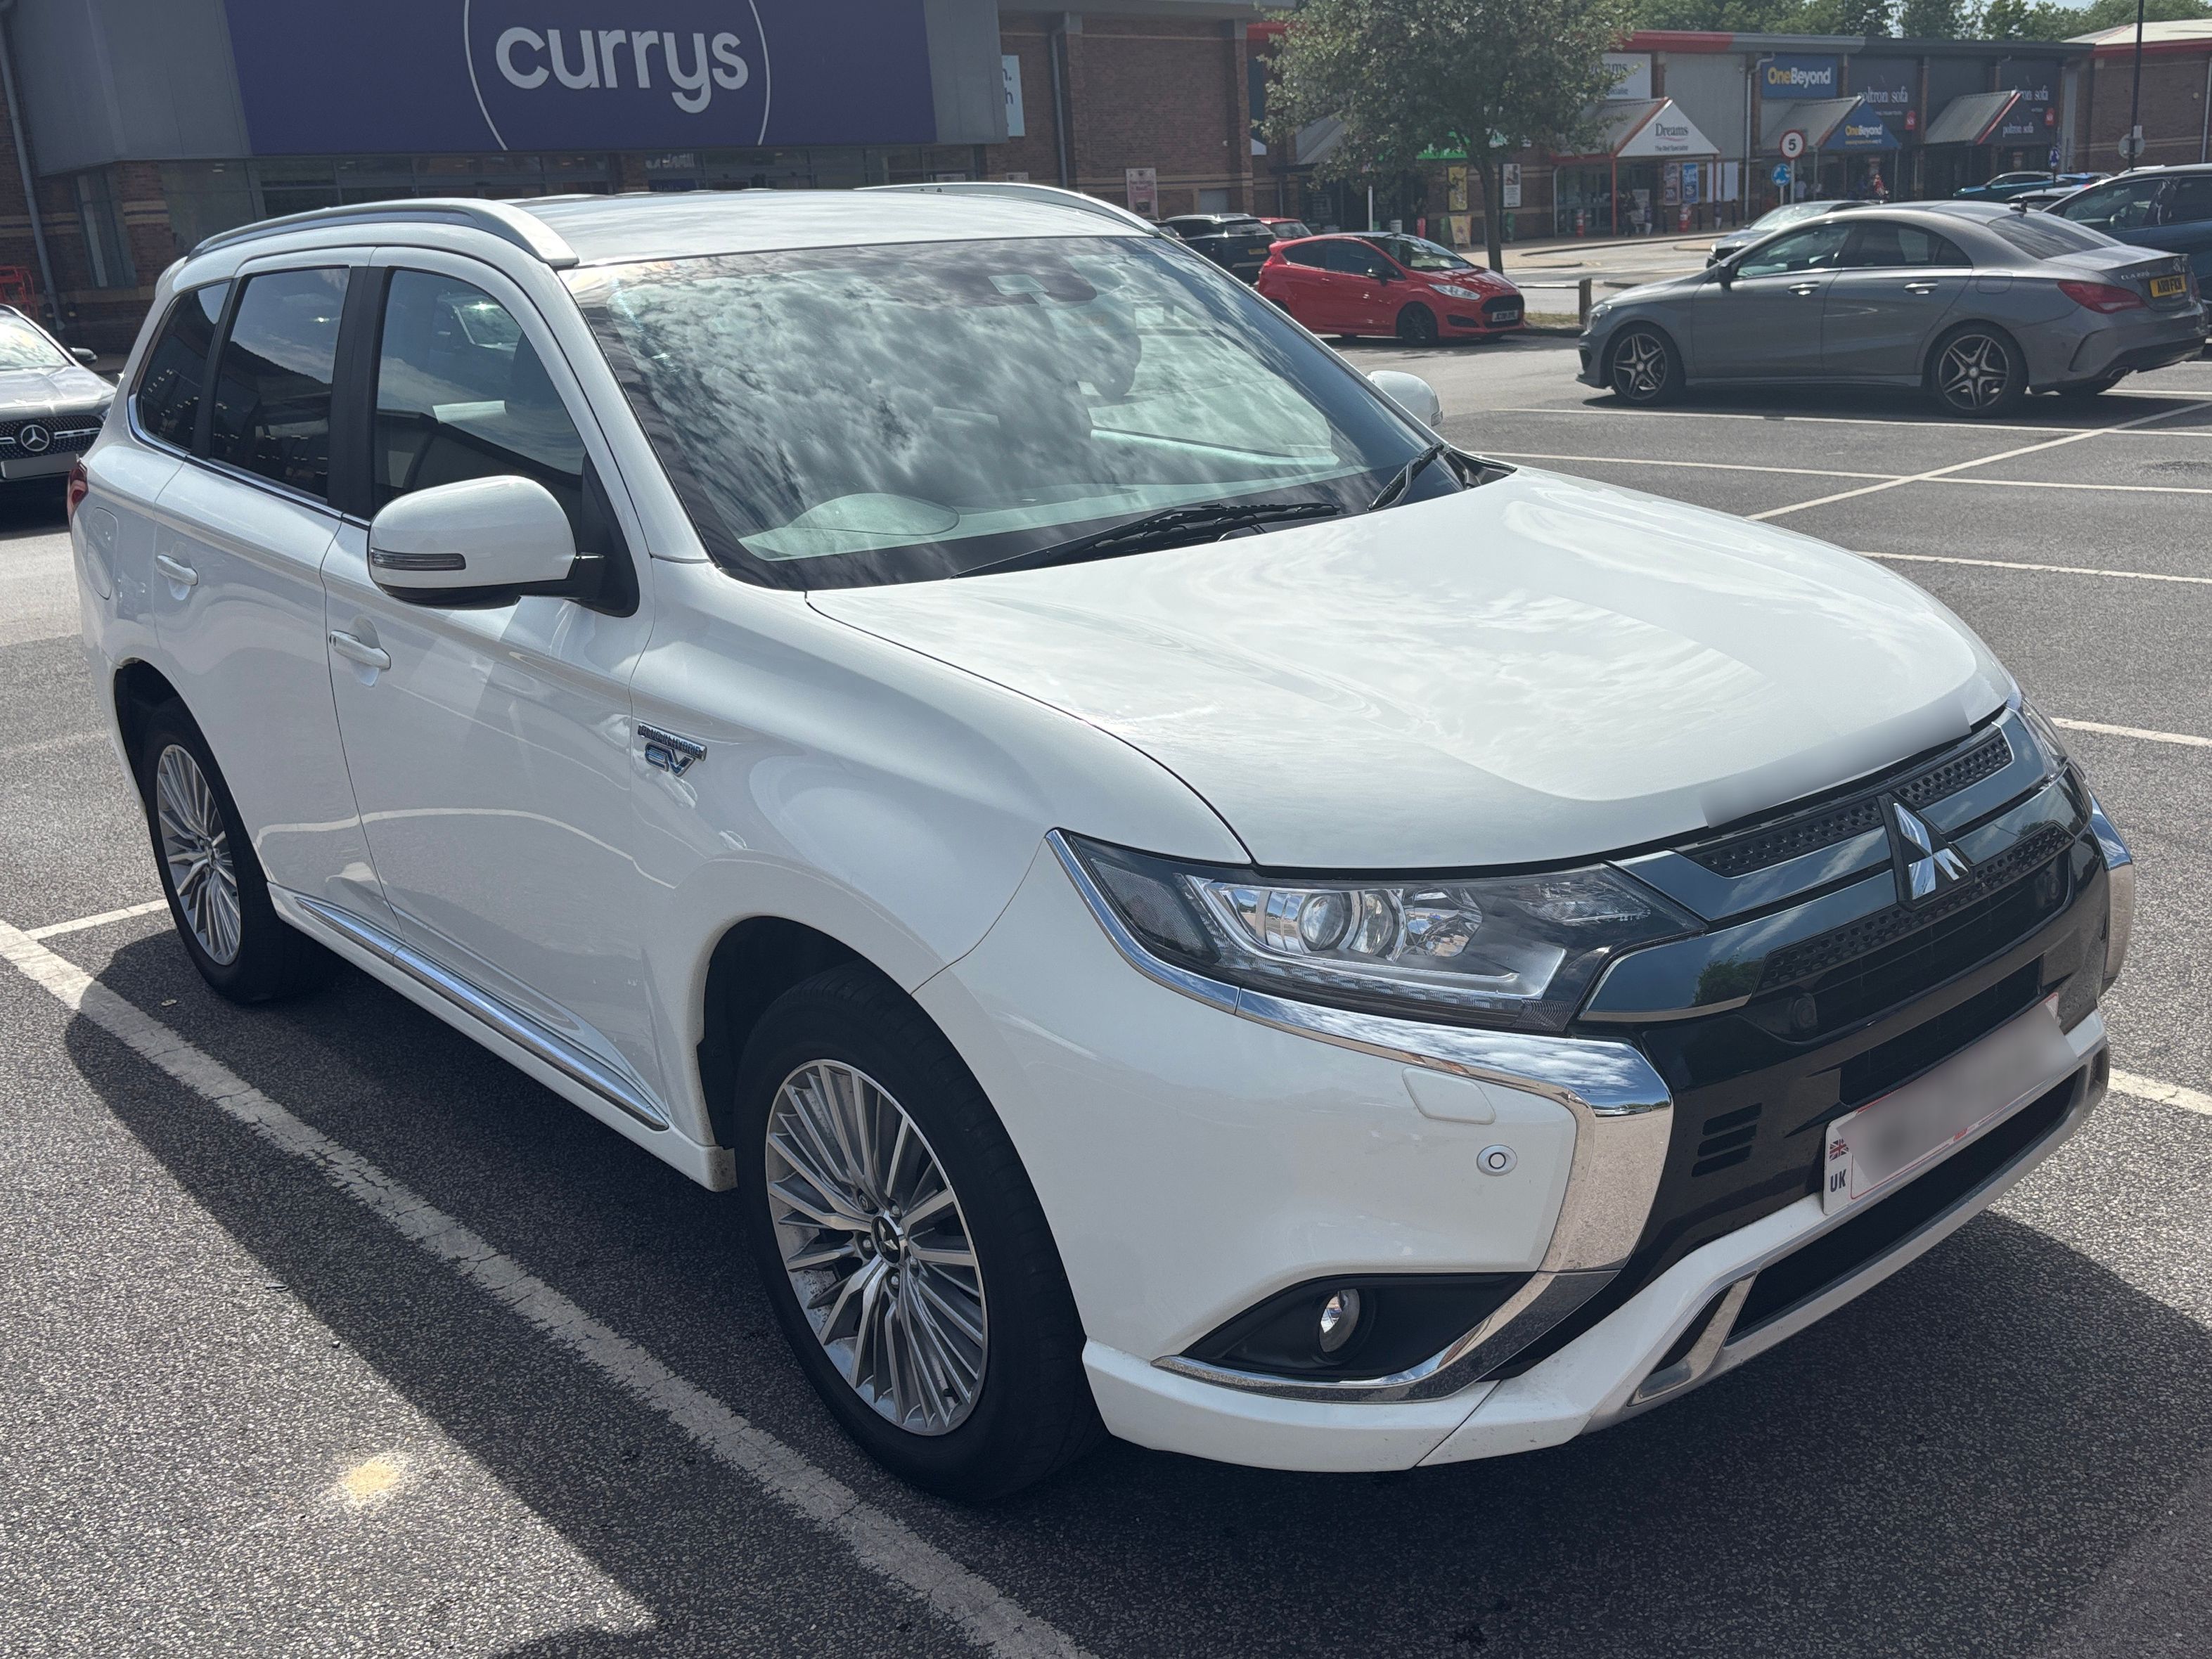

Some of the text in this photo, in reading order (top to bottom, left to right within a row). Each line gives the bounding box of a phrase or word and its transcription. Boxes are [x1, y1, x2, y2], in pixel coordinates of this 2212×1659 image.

[496, 27, 749, 113] currys
[1768, 67, 1831, 89] OneBeyond
[1655, 123, 1689, 136] Dreams
[1845, 124, 1883, 138] OneBeyond
[1788, 138, 1796, 150] 5
[1830, 1168, 1847, 1193] UK
